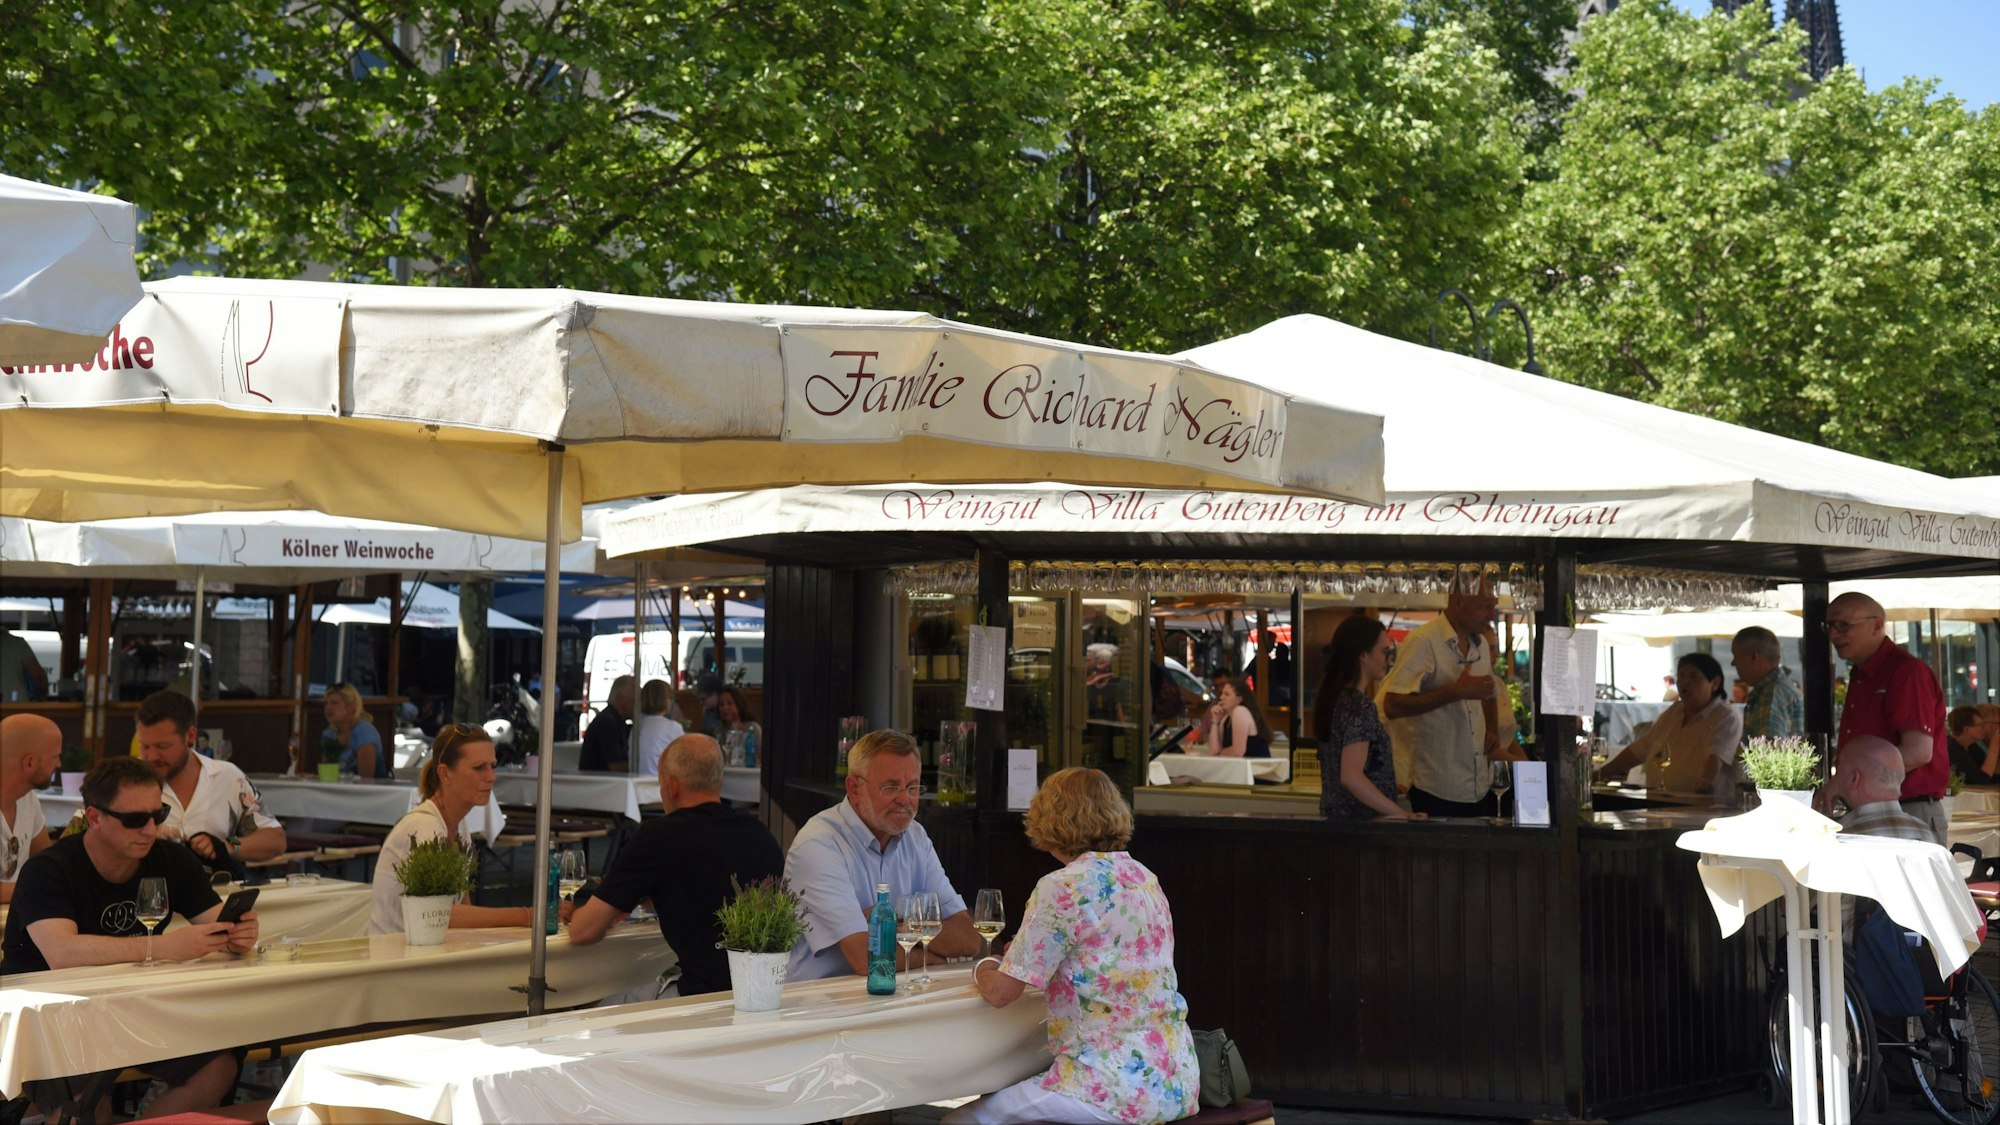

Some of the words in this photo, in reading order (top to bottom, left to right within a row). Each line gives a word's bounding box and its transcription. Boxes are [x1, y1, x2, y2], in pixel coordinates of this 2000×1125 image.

[805, 351, 965, 416] Famlie
[983, 363, 1157, 432] Richard
[1163, 385, 1283, 463] Nägler
[882, 489, 1044, 525] Weingut
[1061, 490, 1165, 520] Villa
[1182, 490, 1354, 528] Gutenberg
[1423, 491, 1621, 532] Rheingau
[1815, 502, 1892, 543] Weingut
[1899, 511, 1943, 543] Villa
[282, 538, 339, 558] Kölner
[344, 540, 434, 560] Weinwoche
[624, 654, 671, 676] Slvia
